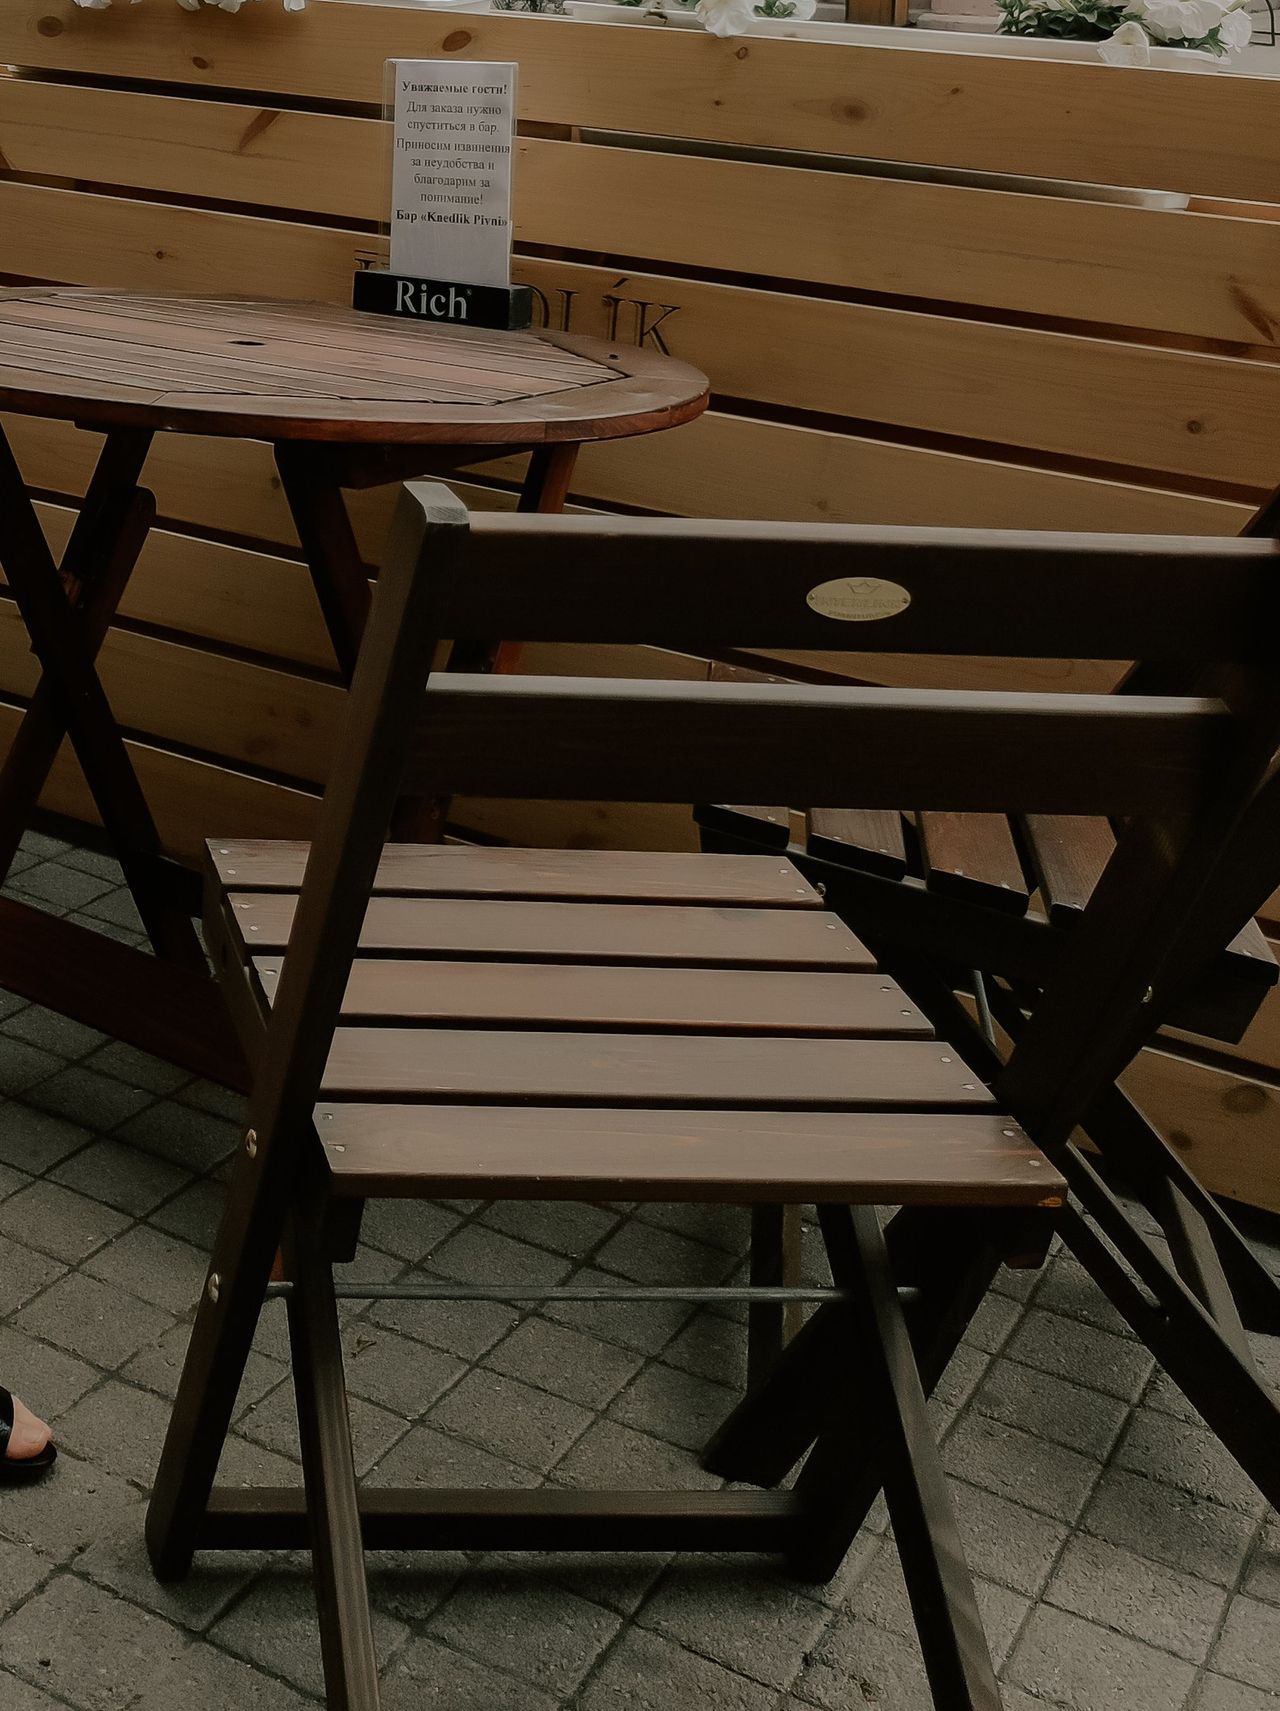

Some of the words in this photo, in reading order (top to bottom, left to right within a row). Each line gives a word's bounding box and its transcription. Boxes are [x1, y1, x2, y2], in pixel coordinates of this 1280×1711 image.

[402, 82, 468, 94] Уважаемые
[472, 84, 508, 94] гости!
[406, 102, 427, 114] Для
[430, 105, 463, 114] заказа
[467, 106, 502, 116] нужно
[408, 121, 466, 132] спуститься
[478, 121, 500, 134] бар.
[396, 138, 450, 151] Приносим
[454, 143, 510, 154] извинения
[410, 158, 421, 166] за
[424, 158, 485, 170] неудобства
[488, 162, 494, 170] и
[414, 174, 476, 188] благодарим
[480, 180, 490, 188] за
[420, 194, 484, 205] понимание!
[396, 210, 418, 224] Бар
[421, 212, 470, 225] «Knedlik
[395, 280, 468, 319] Rich
